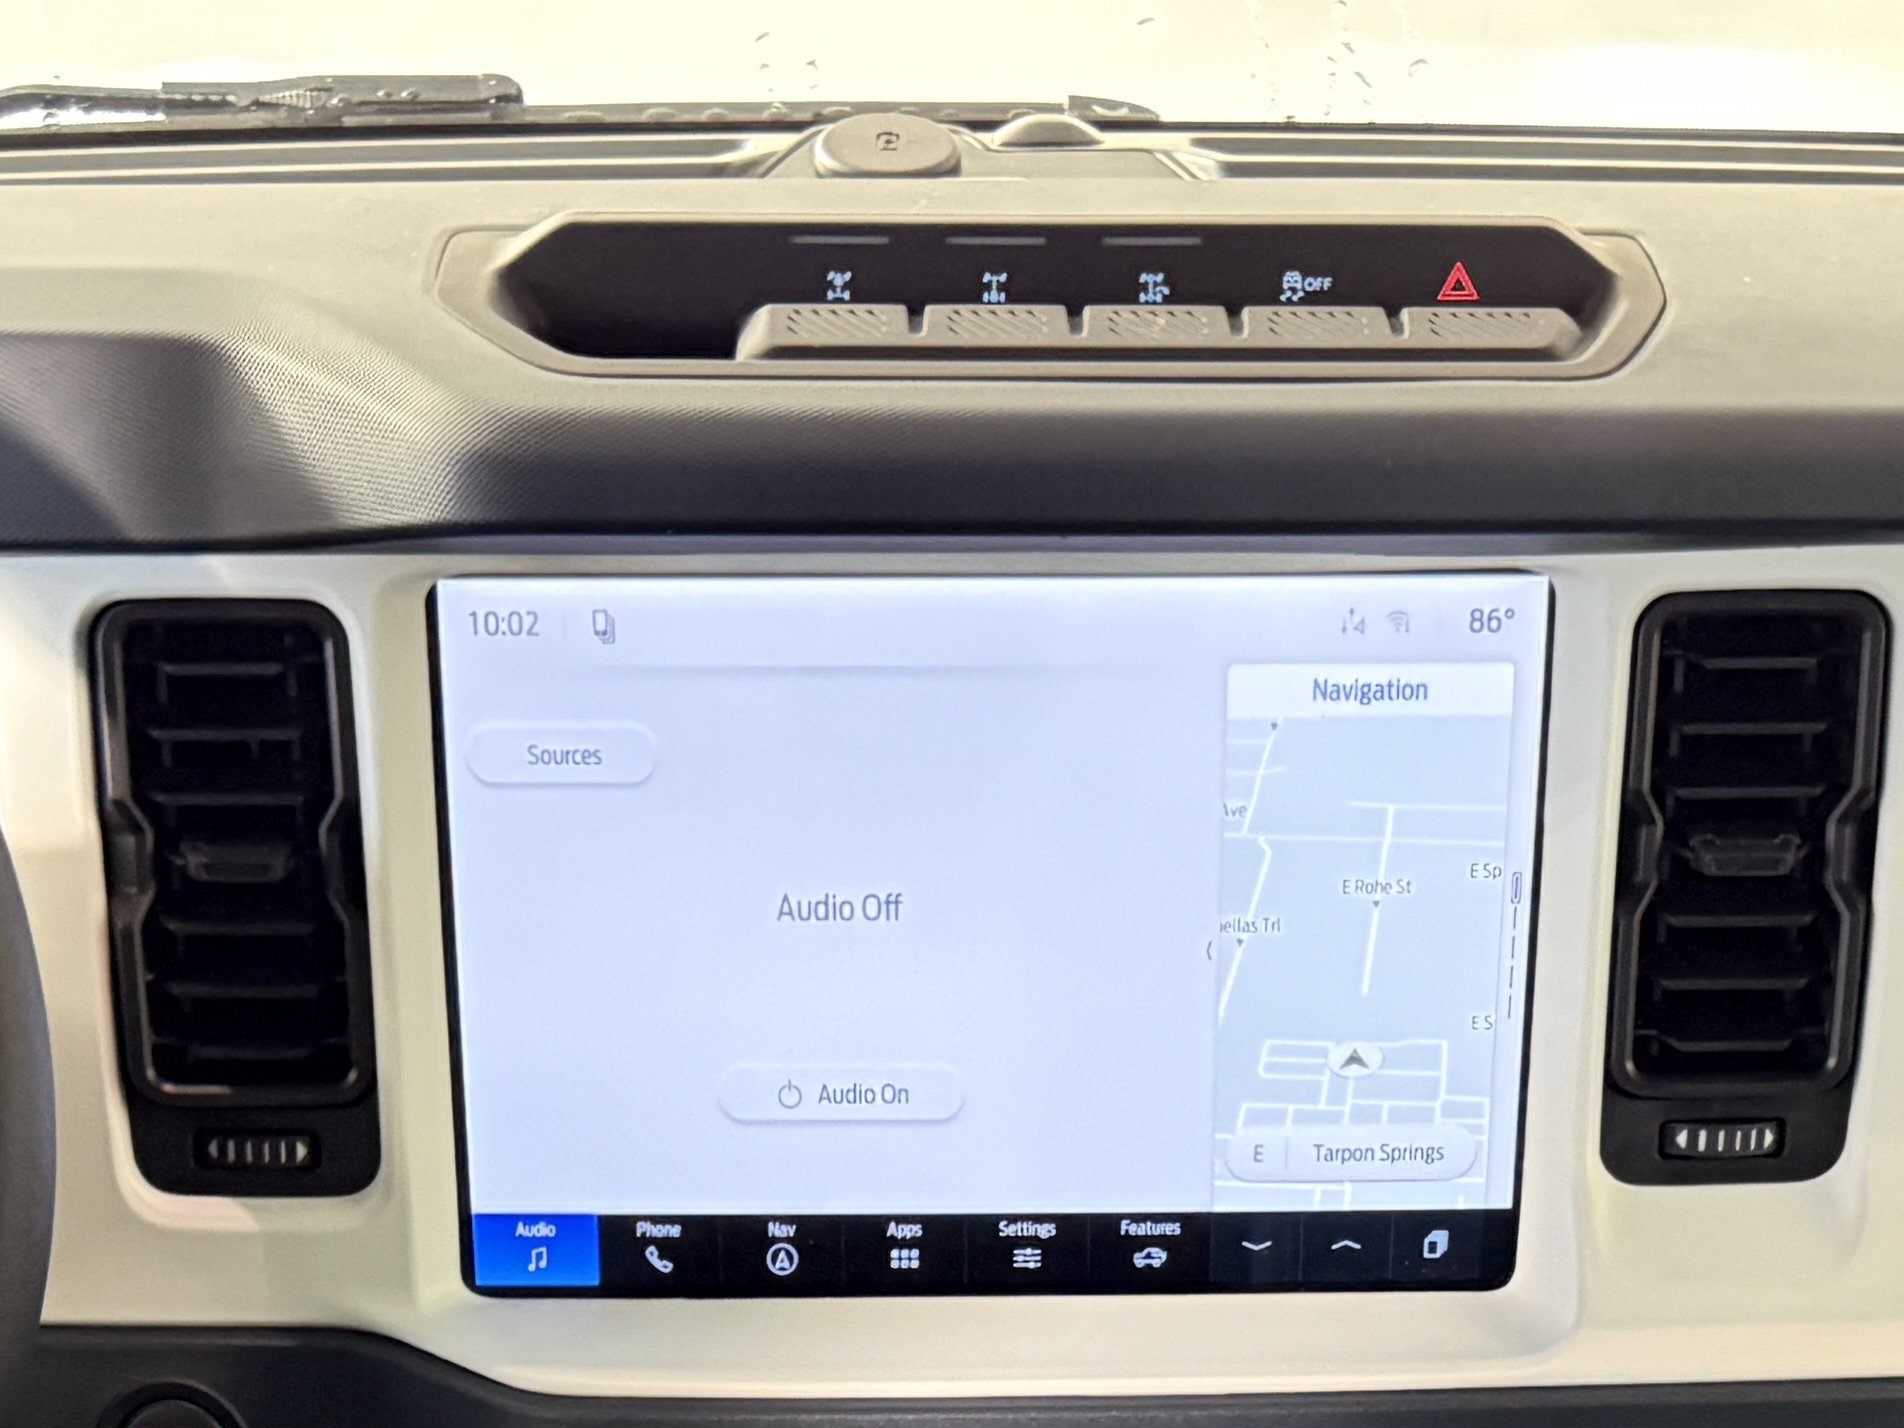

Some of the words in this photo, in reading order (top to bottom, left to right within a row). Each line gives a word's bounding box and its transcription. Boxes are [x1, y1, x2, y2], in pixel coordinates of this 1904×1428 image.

[1304, 277, 1333, 291] OFF
[468, 611, 540, 637] 10:02
[1312, 677, 1429, 706] Navigation
[527, 743, 603, 767] Sources
[1470, 863, 1480, 879] E
[1343, 879, 1351, 895] E
[1396, 879, 1411, 895] St
[777, 893, 855, 923] Audio
[861, 893, 904, 923] Off
[1472, 1016, 1481, 1030] E
[817, 1082, 876, 1105] Audio
[881, 1083, 910, 1104] On
[1253, 1145, 1264, 1163] E
[1313, 1144, 1375, 1164] Tarpon
[1379, 1143, 1445, 1165] Springs
[515, 1221, 556, 1238] Audio
[636, 1221, 681, 1238] Phone
[768, 1222, 797, 1238] Nav
[886, 1221, 923, 1241] Apps
[999, 1219, 1057, 1240] Settings
[1119, 1219, 1182, 1237] Features
